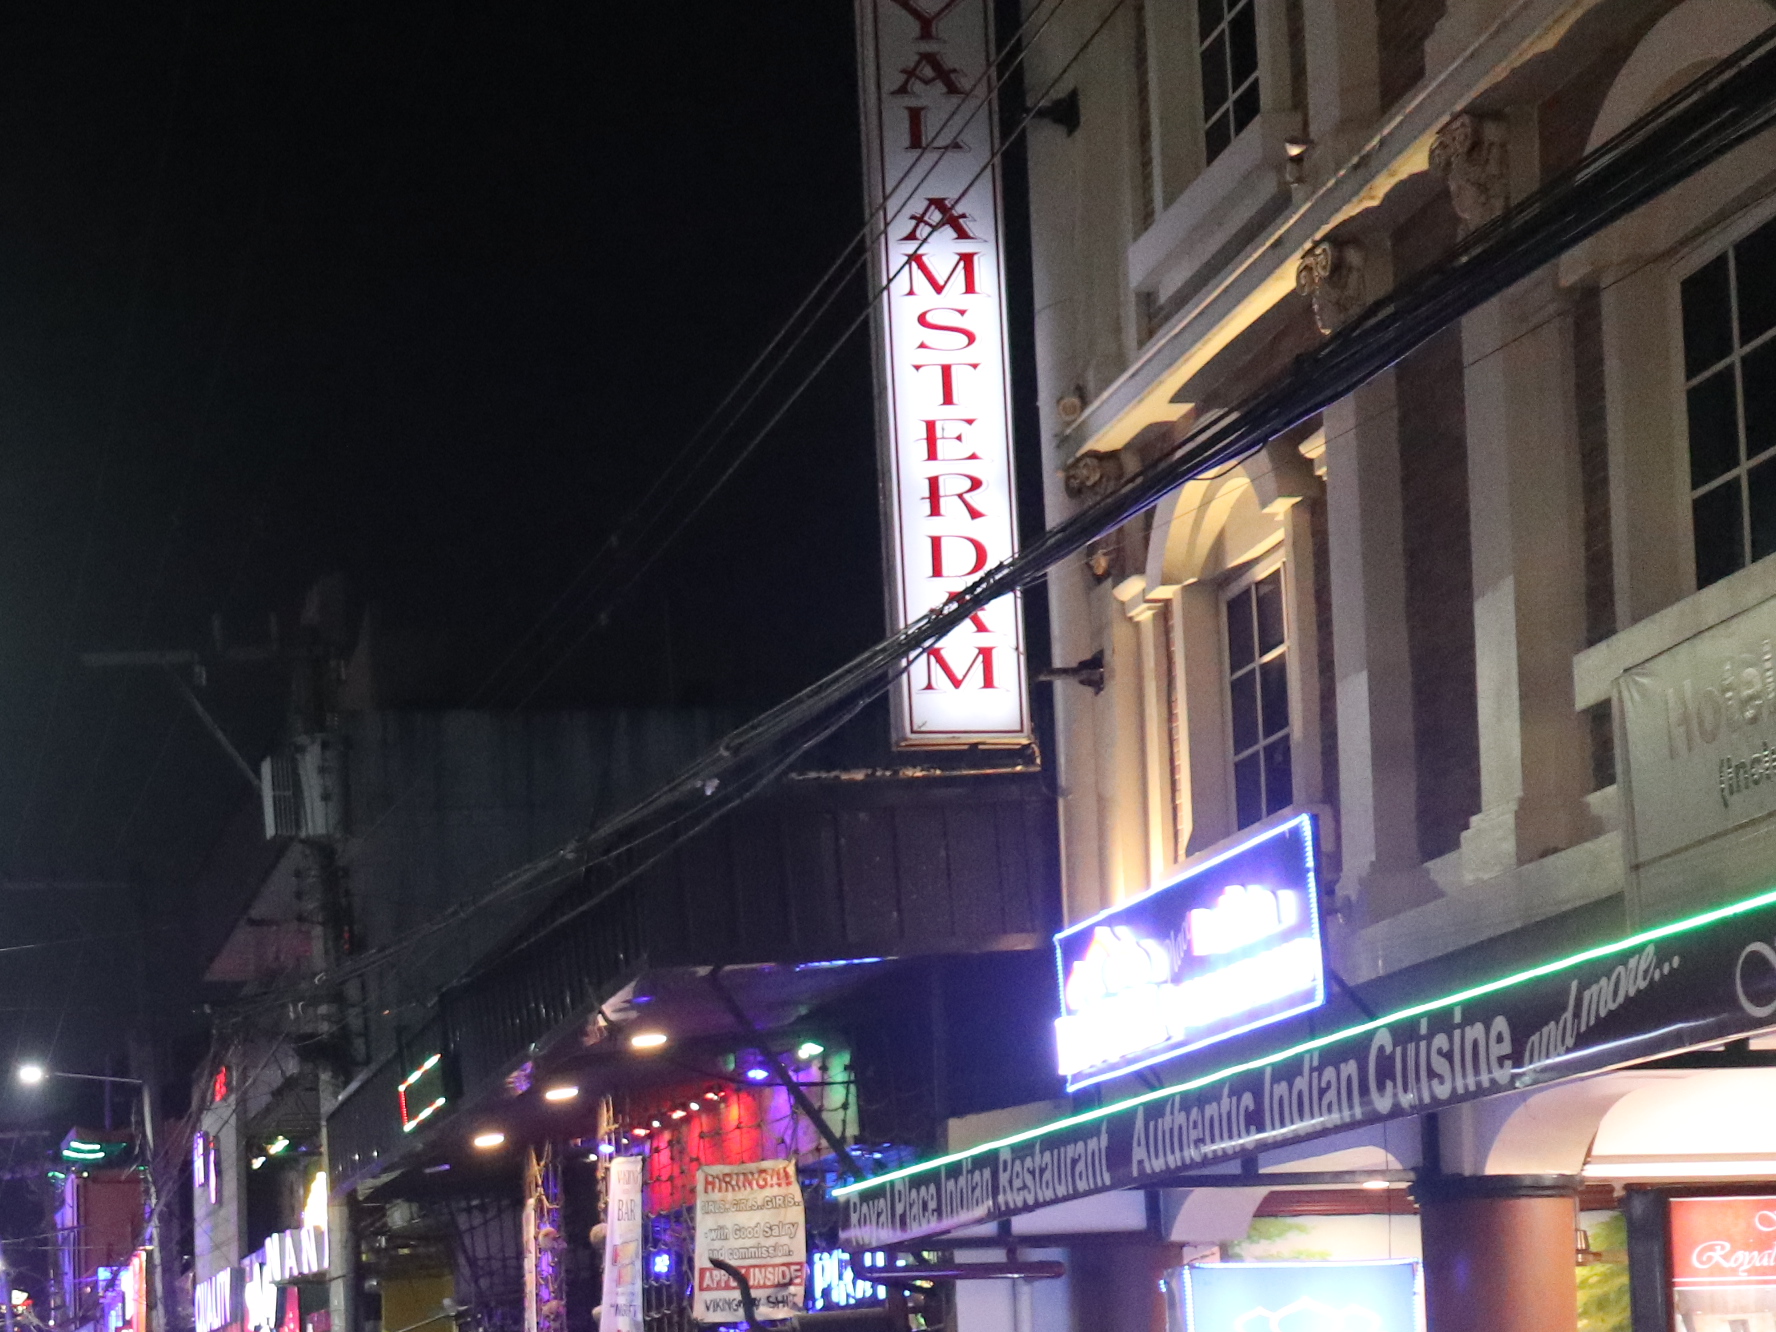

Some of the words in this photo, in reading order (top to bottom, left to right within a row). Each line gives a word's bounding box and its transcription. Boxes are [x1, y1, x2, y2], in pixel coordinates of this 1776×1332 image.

[849, 1182, 892, 1247] Royal
[894, 1177, 938, 1234] Place
[940, 1157, 995, 1223] Indian
[997, 1119, 1111, 1209] Restaurant
[1131, 1080, 1257, 1178] Authentic
[1263, 1049, 1363, 1143] Indian
[1368, 1006, 1514, 1116] Cuisine
[750, 1264, 802, 1287] INSIDE
